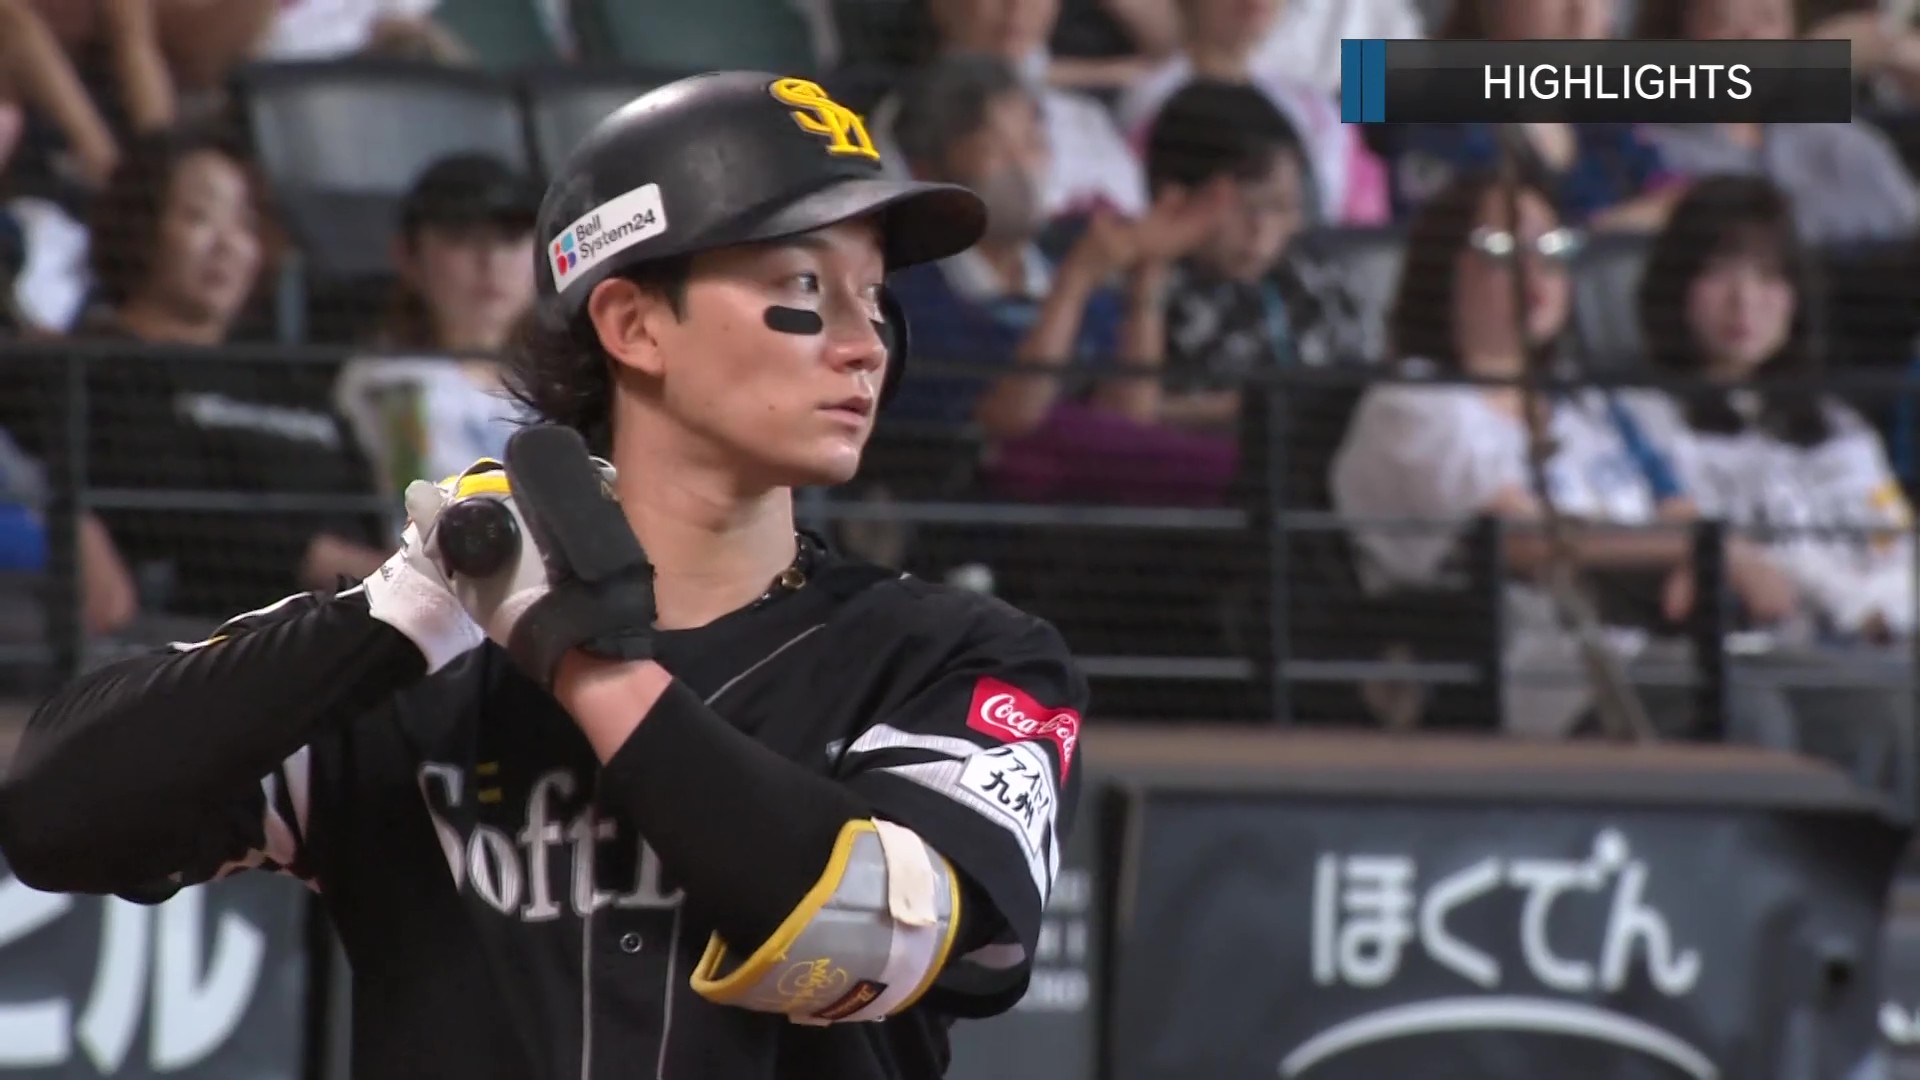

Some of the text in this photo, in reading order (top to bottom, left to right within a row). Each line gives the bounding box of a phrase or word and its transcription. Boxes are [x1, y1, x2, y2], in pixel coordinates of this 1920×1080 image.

[576, 213, 601, 242] Bell
[579, 208, 656, 259] System24
[980, 769, 1034, 831] 九州
[1313, 828, 1700, 994] ほくでん
